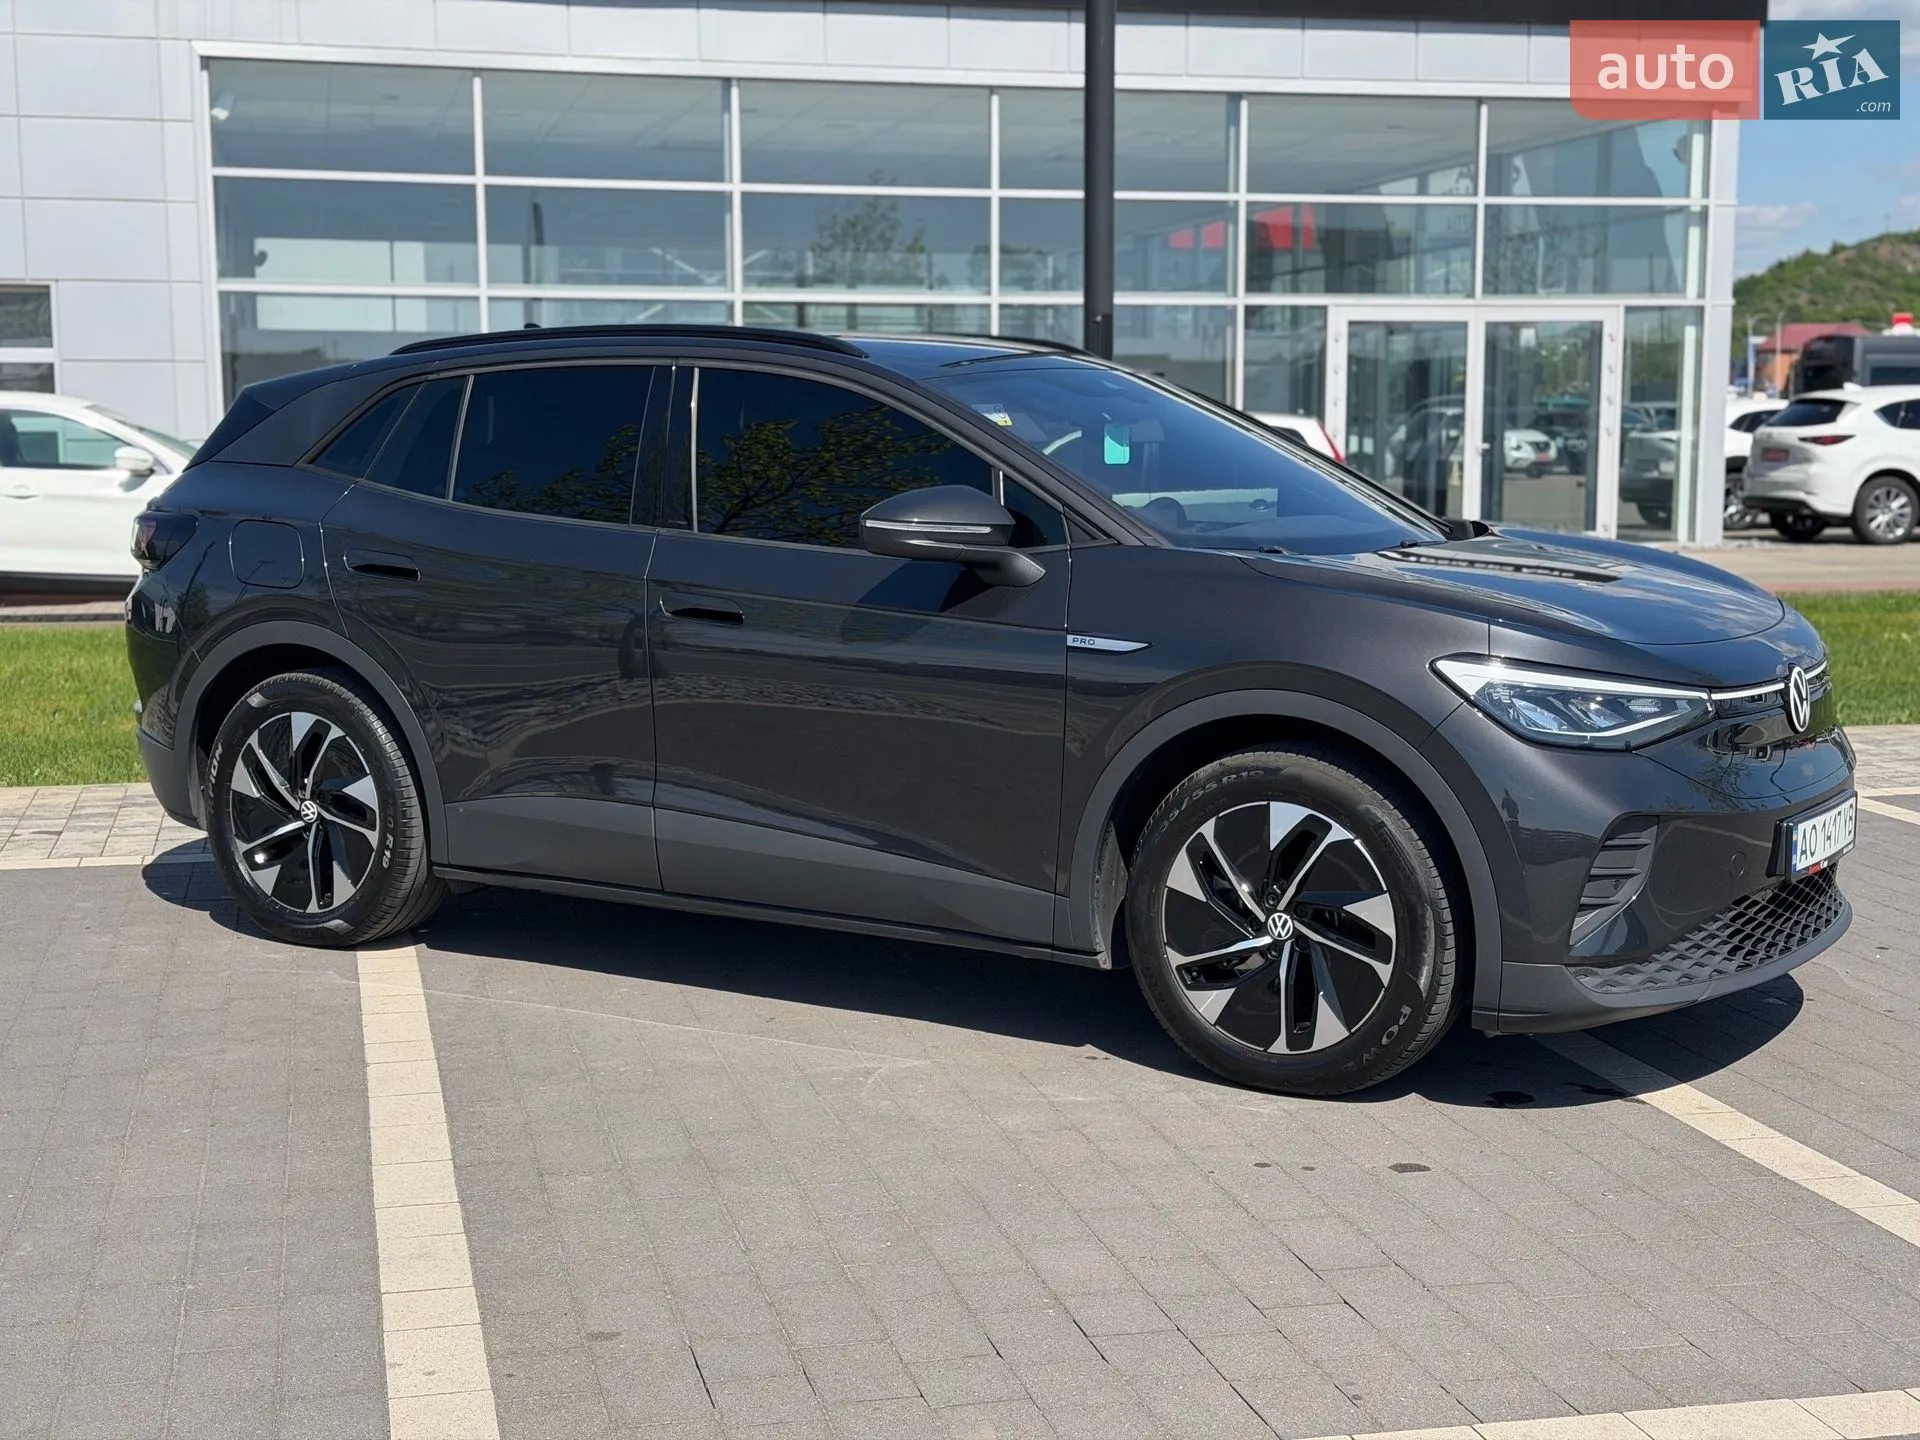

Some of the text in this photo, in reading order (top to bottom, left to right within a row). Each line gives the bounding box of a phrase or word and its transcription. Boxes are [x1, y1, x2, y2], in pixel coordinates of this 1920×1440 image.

[1072, 637, 1096, 646] PRO
[1799, 803, 1854, 863] AO 1417 YB
